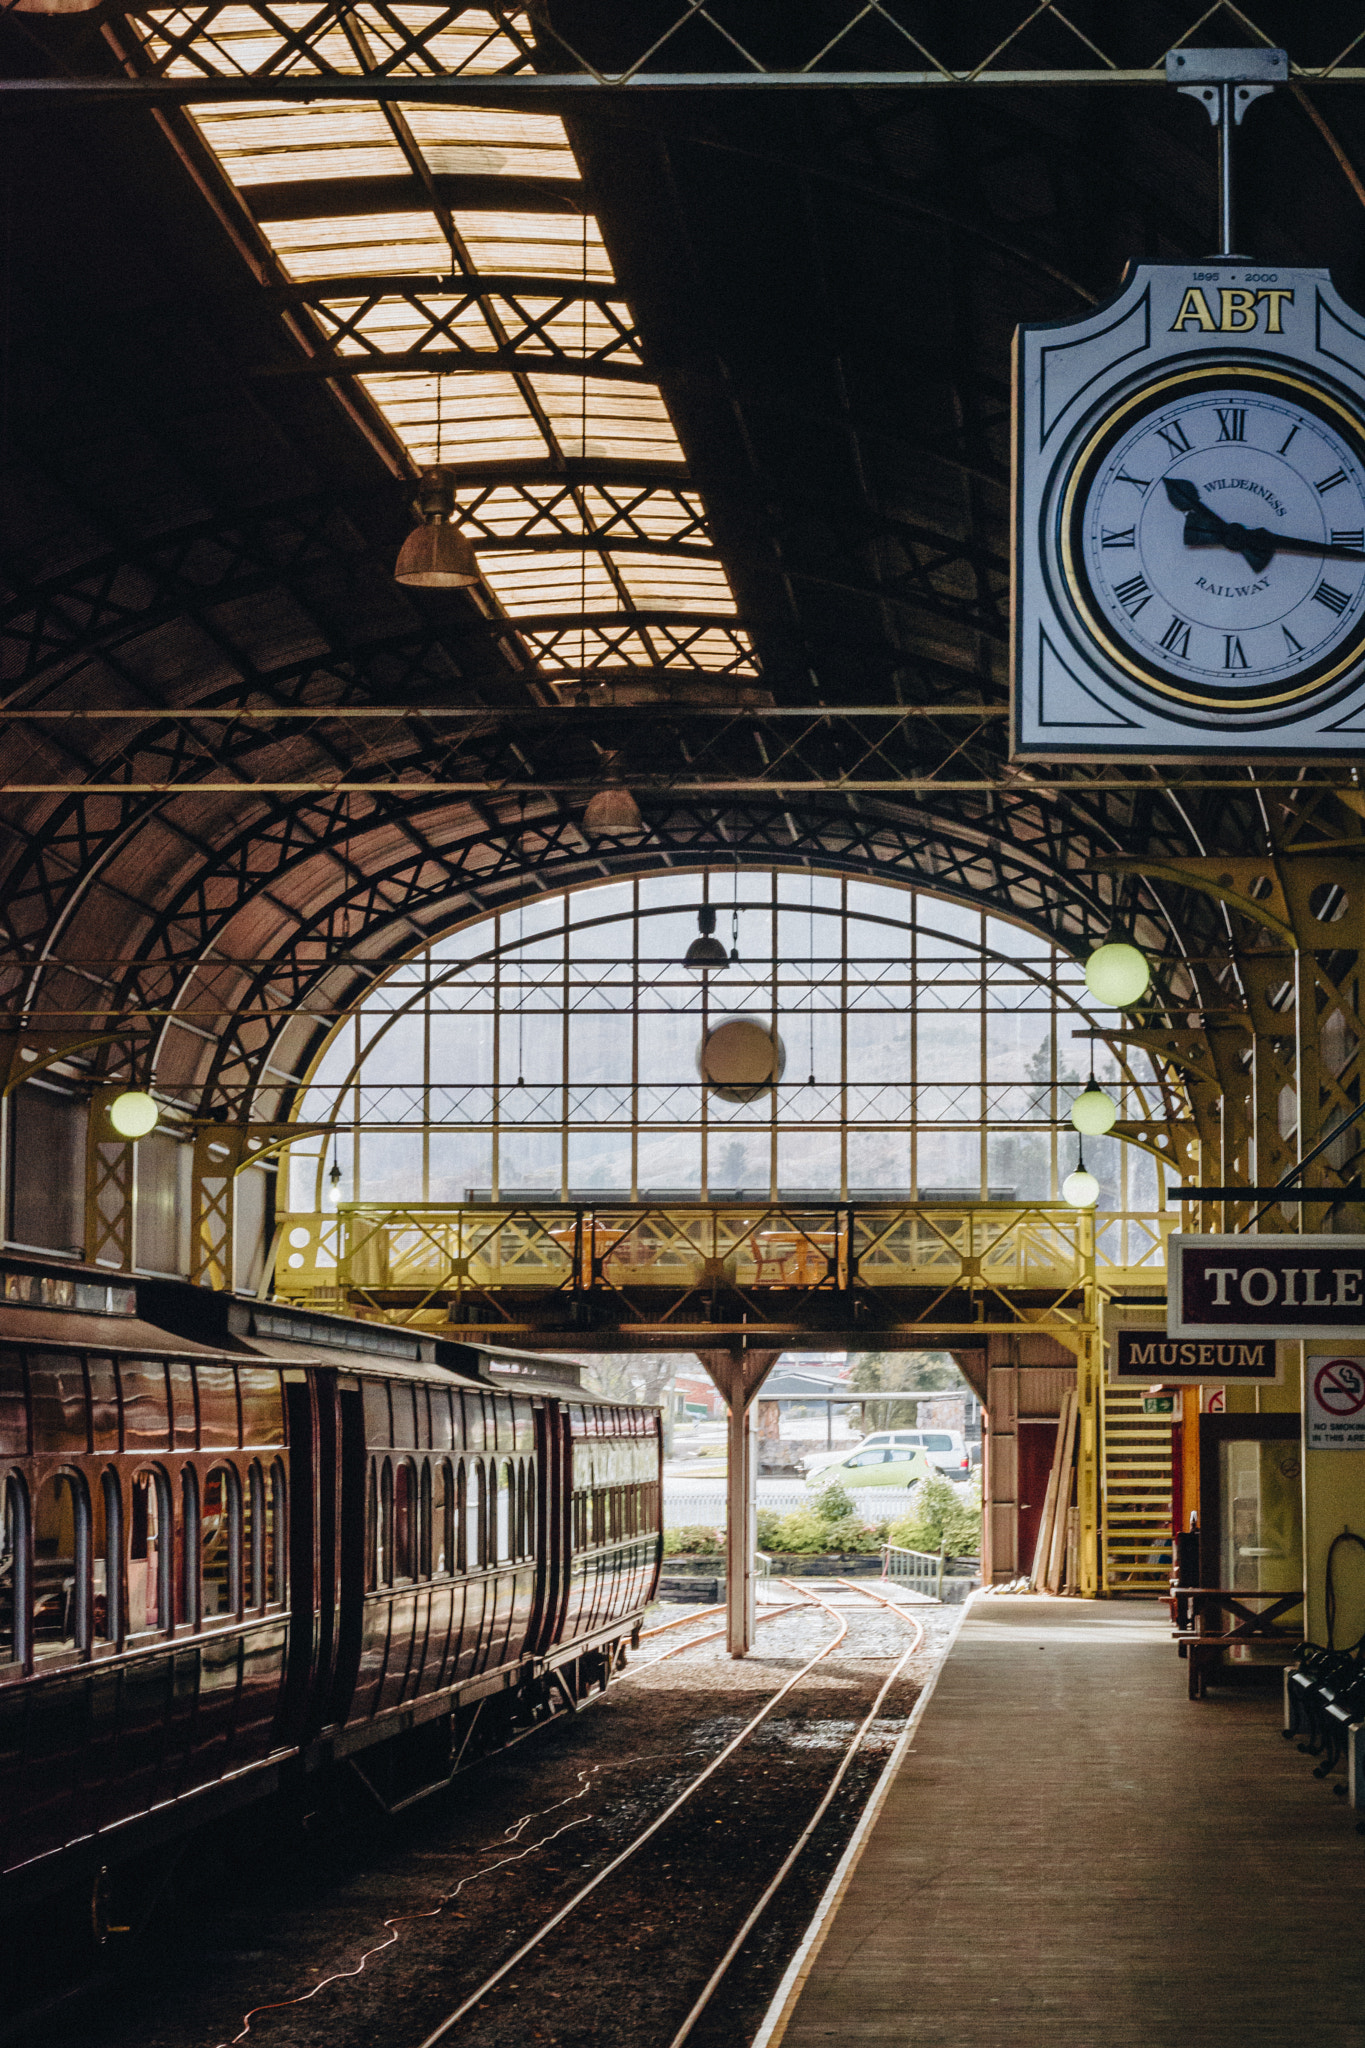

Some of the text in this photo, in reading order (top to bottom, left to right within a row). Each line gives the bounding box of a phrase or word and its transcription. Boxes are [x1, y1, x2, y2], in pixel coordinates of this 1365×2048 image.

[1193, 272, 1278, 282] 1895 2000
[1167, 286, 1295, 334] ABT
[1153, 418, 1196, 462] XI
[1213, 408, 1249, 442] XII
[1276, 423, 1302, 456] I
[1112, 463, 1155, 498] X
[1203, 478, 1288, 517] WILDERNESS
[1313, 466, 1351, 498] II
[1101, 523, 1137, 550] IX
[1330, 527, 1365, 551] III
[1111, 571, 1154, 622] VIII
[1194, 575, 1271, 598] RAILWAY
[1155, 614, 1192, 661] VII
[1221, 634, 1252, 669] VI
[1281, 623, 1307, 658] V
[1204, 1267, 1364, 1307] TOILE
[1129, 1343, 1266, 1367] MUSEUM
[1312, 1434, 1322, 1442] IN
[1324, 1434, 1344, 1442] THIS
[1313, 1422, 1328, 1431] NO
